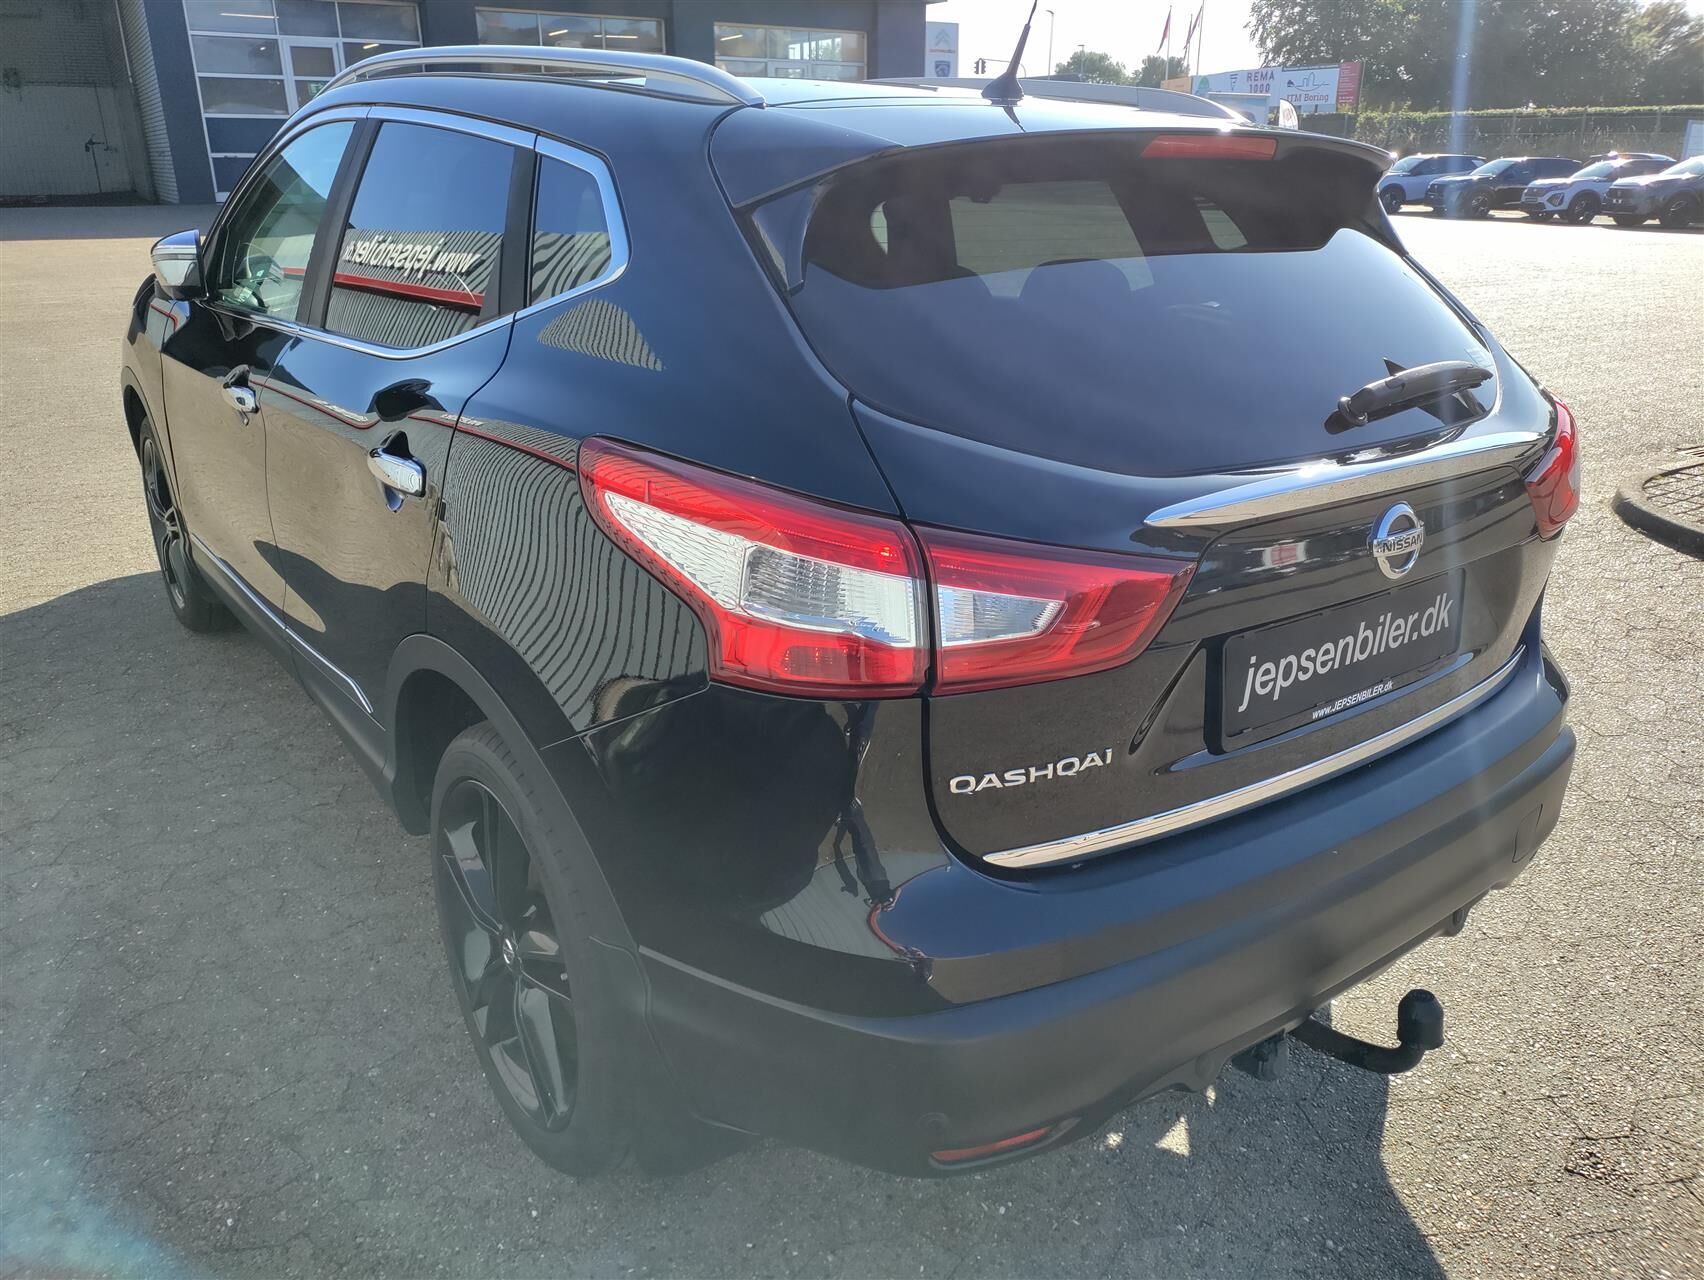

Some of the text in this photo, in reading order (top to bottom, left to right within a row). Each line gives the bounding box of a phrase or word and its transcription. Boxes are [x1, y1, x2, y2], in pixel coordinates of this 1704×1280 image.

[1246, 71, 1275, 83] REMA
[1249, 83, 1271, 94] 1000
[1304, 93, 1329, 104] Boring
[1382, 533, 1423, 553] NISSAN
[1237, 592, 1454, 713] jepsenbiler.dk
[1312, 680, 1394, 720] www.JEPSENBILER.dk
[949, 748, 1113, 795] QASHQAI
